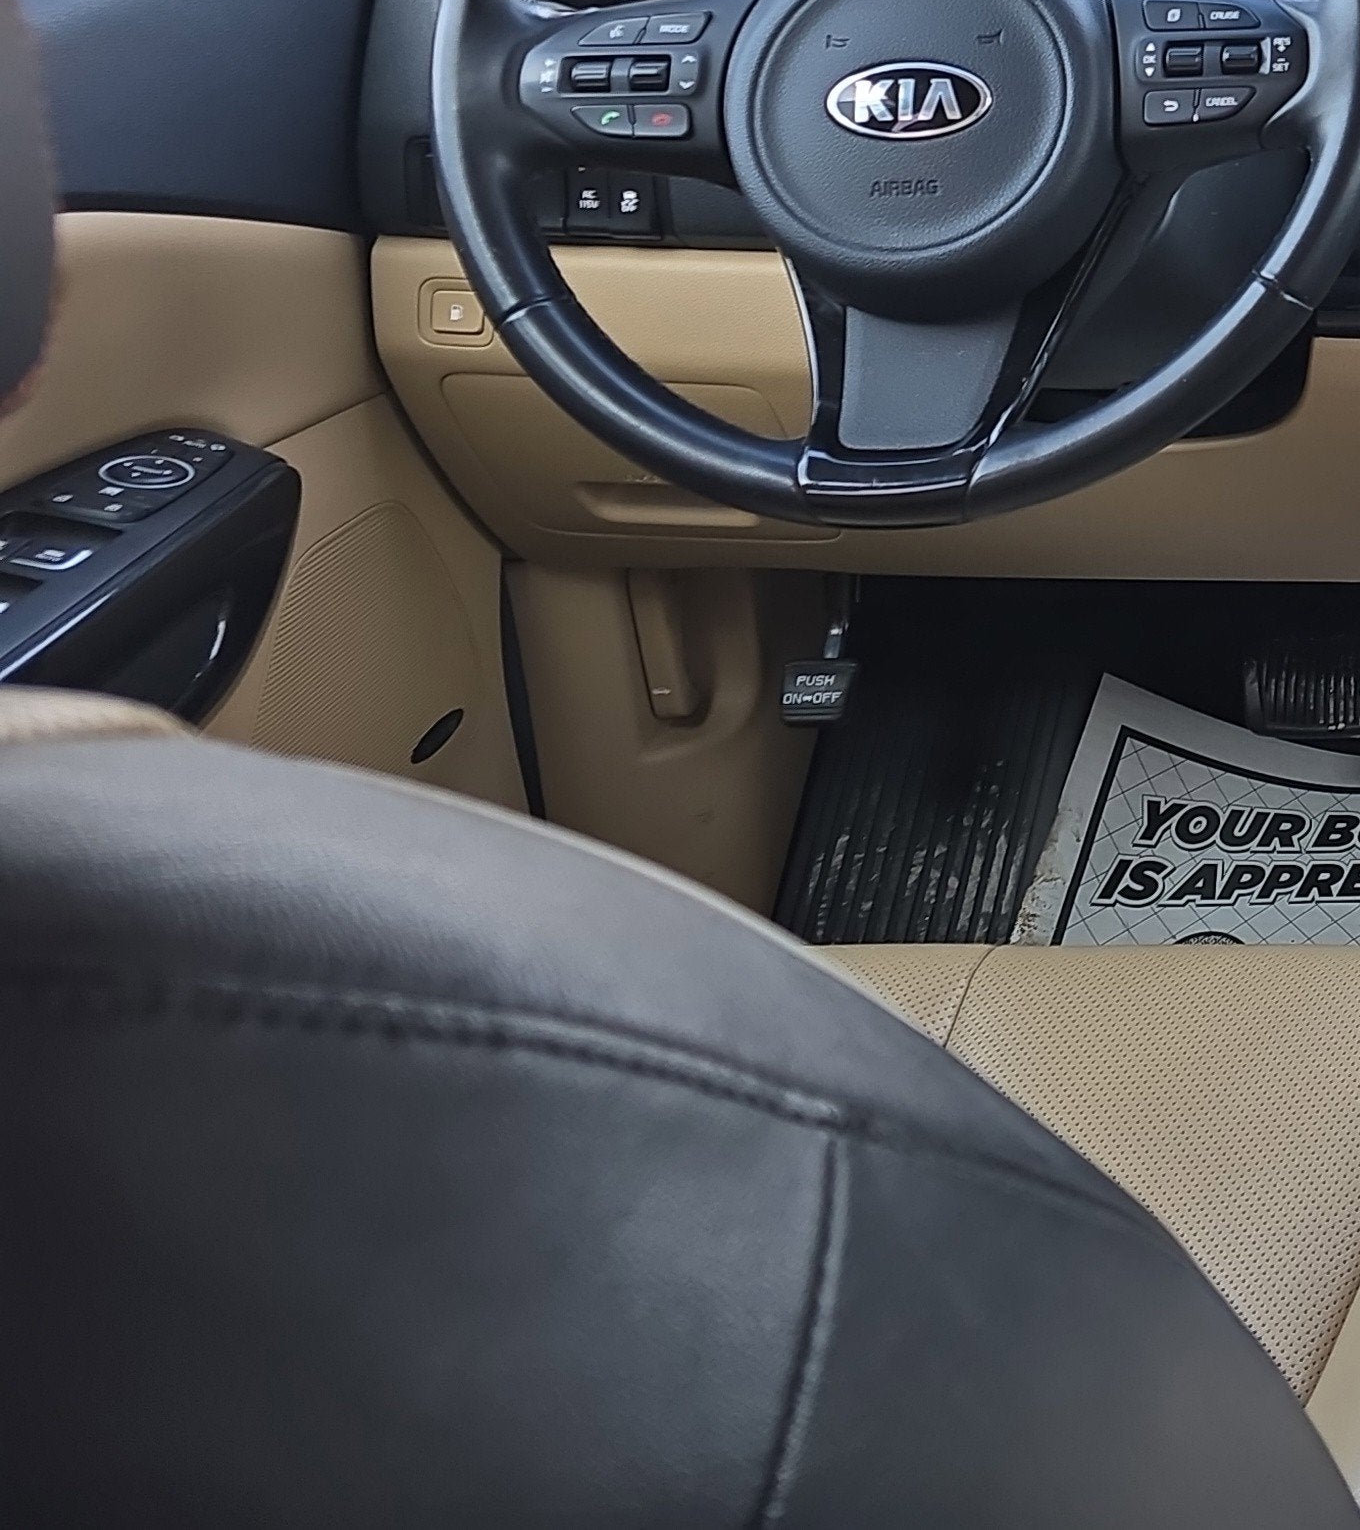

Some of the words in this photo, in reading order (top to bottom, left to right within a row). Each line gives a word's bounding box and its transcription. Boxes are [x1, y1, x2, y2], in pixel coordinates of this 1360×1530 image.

[854, 78, 963, 123] KIA
[869, 179, 939, 197] AIRBAG
[795, 674, 837, 687] PUSH
[1133, 795, 1311, 854] YOUR
[1091, 857, 1167, 908] IS
